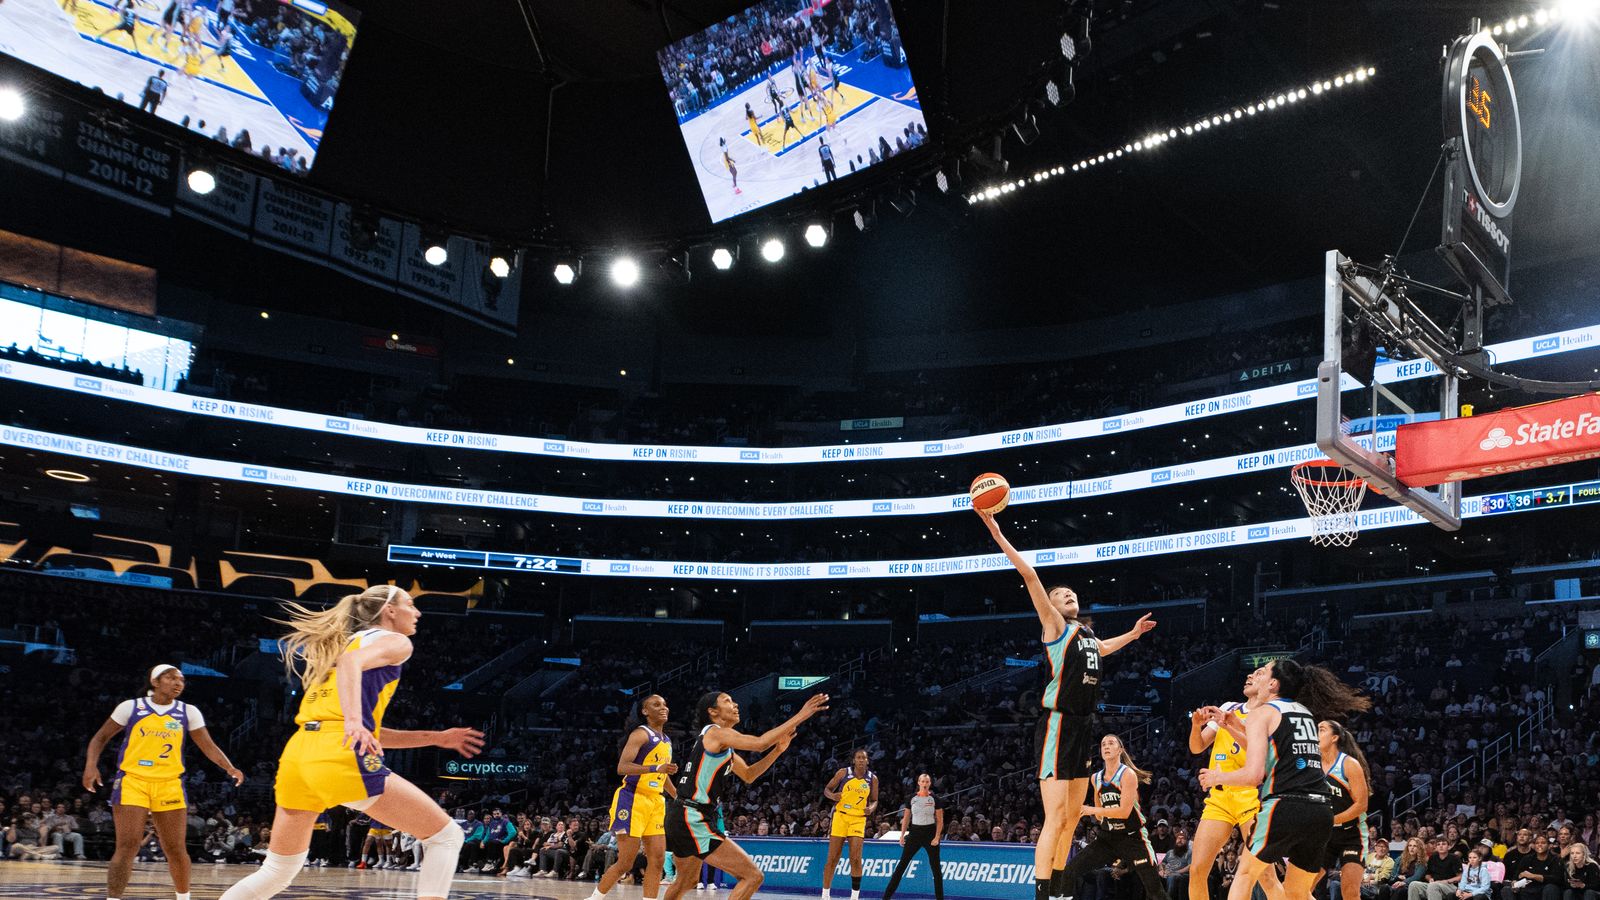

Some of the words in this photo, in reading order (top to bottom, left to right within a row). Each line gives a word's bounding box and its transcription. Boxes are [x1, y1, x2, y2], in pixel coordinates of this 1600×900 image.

[76, 135, 169, 180] CHAMPIONS
[142, 146, 170, 164] CUP
[88, 158, 154, 196] 2011-12
[1476, 202, 1510, 253] TISSOT
[1536, 340, 1558, 351] UCLA
[1562, 332, 1594, 347] Health
[1252, 362, 1292, 378] DELTA
[1396, 362, 1422, 378] KEEP
[78, 379, 99, 390] UCLA
[104, 384, 135, 397] Health
[192, 399, 218, 412] KEEP
[221, 403, 236, 415] ON
[239, 406, 274, 420] RISING
[1185, 404, 1207, 416] KEEP
[1208, 400, 1220, 412] ON
[1222, 394, 1252, 409] RISING
[329, 420, 348, 431] UCLA
[352, 422, 378, 434] Health
[871, 419, 892, 428] Health
[1104, 421, 1121, 430] UCLA
[1122, 416, 1144, 428] Health
[426, 432, 450, 443] KEEP
[452, 434, 464, 444] ON
[467, 436, 498, 448] RISING
[1002, 432, 1021, 445] KEEP
[1023, 432, 1034, 442] ON
[1036, 428, 1062, 440] RISING
[1514, 418, 1575, 446] State
[2, 429, 82, 454] OVERCOMING
[86, 442, 122, 460] EVERY
[126, 448, 190, 471] CHALLENGE
[546, 444, 564, 452] UCLA
[566, 445, 590, 455] Health
[633, 448, 654, 458] KEEP
[656, 448, 668, 458] ON
[670, 449, 698, 460] RISING
[742, 452, 758, 460] UCLA
[761, 450, 784, 460] Health
[822, 448, 842, 459] KEEP
[844, 448, 854, 458] ON
[857, 446, 884, 457] RISING
[926, 444, 942, 453] UCLA
[944, 442, 965, 452] Health
[1237, 456, 1260, 470] KEEP
[1262, 454, 1275, 467] ON
[1278, 447, 1324, 463] OVERCOM
[244, 467, 267, 479] UCLA
[270, 470, 298, 484] Health
[1153, 472, 1170, 482] UCLA
[1172, 467, 1196, 479] Health
[1480, 460, 1545, 475] State
[346, 480, 372, 494] KEEP
[374, 484, 389, 495] ON
[392, 486, 453, 502] OVERCOMING
[456, 492, 484, 504] EVERY
[486, 494, 539, 508] CHALLENGE
[952, 496, 971, 509] KEEP
[1038, 486, 1063, 498] EVERY
[1066, 480, 1112, 496] CHALLENGE
[1490, 499, 1504, 510] 30
[1516, 495, 1530, 507] 36
[1546, 491, 1564, 504] 3.7
[584, 503, 602, 512] UCLA
[604, 504, 628, 514] Health
[668, 504, 688, 514] KEEP
[691, 504, 703, 514] ON
[706, 504, 760, 516] OVERCOMING
[762, 504, 788, 516] EVERY
[790, 504, 834, 516] CHALLENGE
[874, 503, 890, 512] UCLA
[893, 501, 916, 512] Health
[1361, 509, 1414, 527] BELIEVING
[1250, 528, 1268, 538] UCLA
[1271, 524, 1296, 536] Health
[1096, 546, 1116, 558] KEEP
[1118, 544, 1130, 556] ON
[1132, 538, 1174, 554] BELIEVING
[1176, 536, 1192, 548] IT'S
[1194, 530, 1236, 547] POSSIBLE
[421, 550, 434, 558] Air
[435, 552, 456, 560] West
[514, 556, 558, 570] 7:24
[1038, 552, 1055, 562] UCLA
[1056, 550, 1079, 561] Health
[611, 564, 628, 572] UCLA
[632, 564, 655, 574] Health
[672, 564, 695, 575] KEEP
[696, 565, 708, 576] ON
[710, 566, 754, 577] BELIEVING
[756, 566, 771, 577] IT'S
[773, 565, 811, 577] POSSIBLE
[830, 566, 847, 574] UCLA
[849, 564, 871, 575] Health
[888, 562, 910, 574] KEEP
[911, 562, 923, 574] ON
[924, 559, 962, 574] BELIEVING
[964, 558, 979, 570] IT'S
[981, 556, 1013, 568] POSSIBL
[1086, 652, 1098, 670] 21
[1288, 716, 1319, 741] 30
[158, 744, 172, 758] 2
[856, 796, 864, 805] 7
